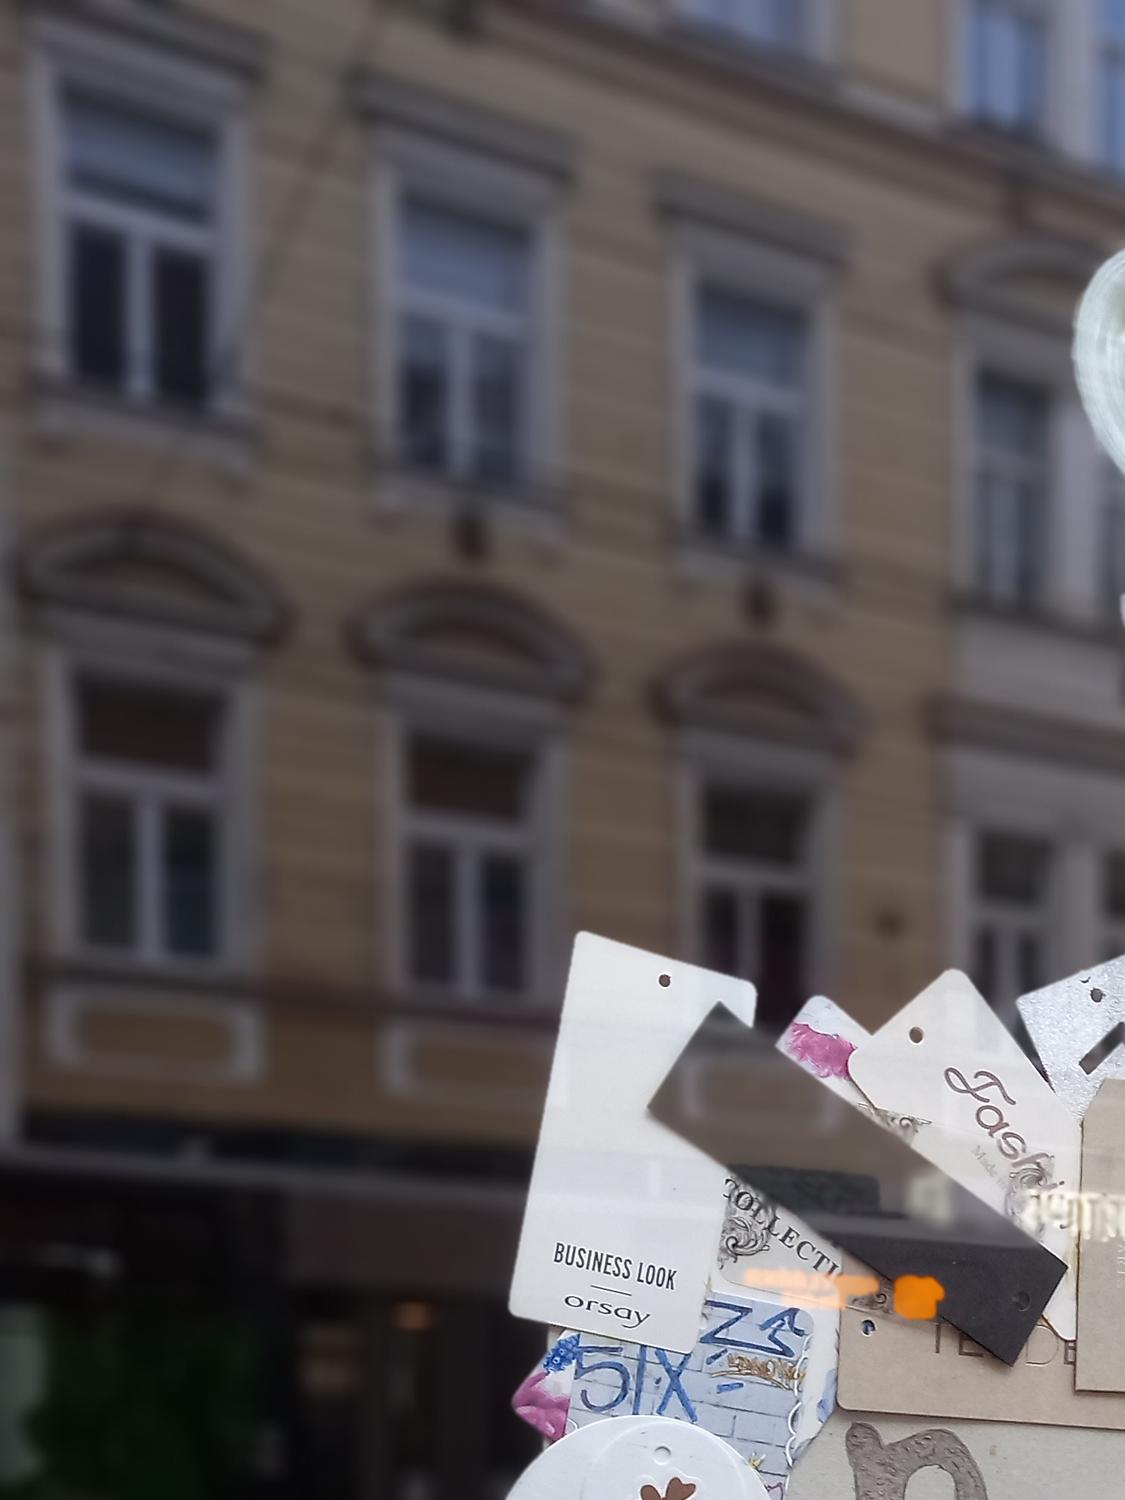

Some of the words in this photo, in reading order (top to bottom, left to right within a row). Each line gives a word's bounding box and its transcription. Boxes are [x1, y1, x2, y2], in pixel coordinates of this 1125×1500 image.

[553, 1242, 633, 1279] BUSINESS
[637, 1262, 677, 1290] LOOK
[564, 1295, 650, 1328] orsay
